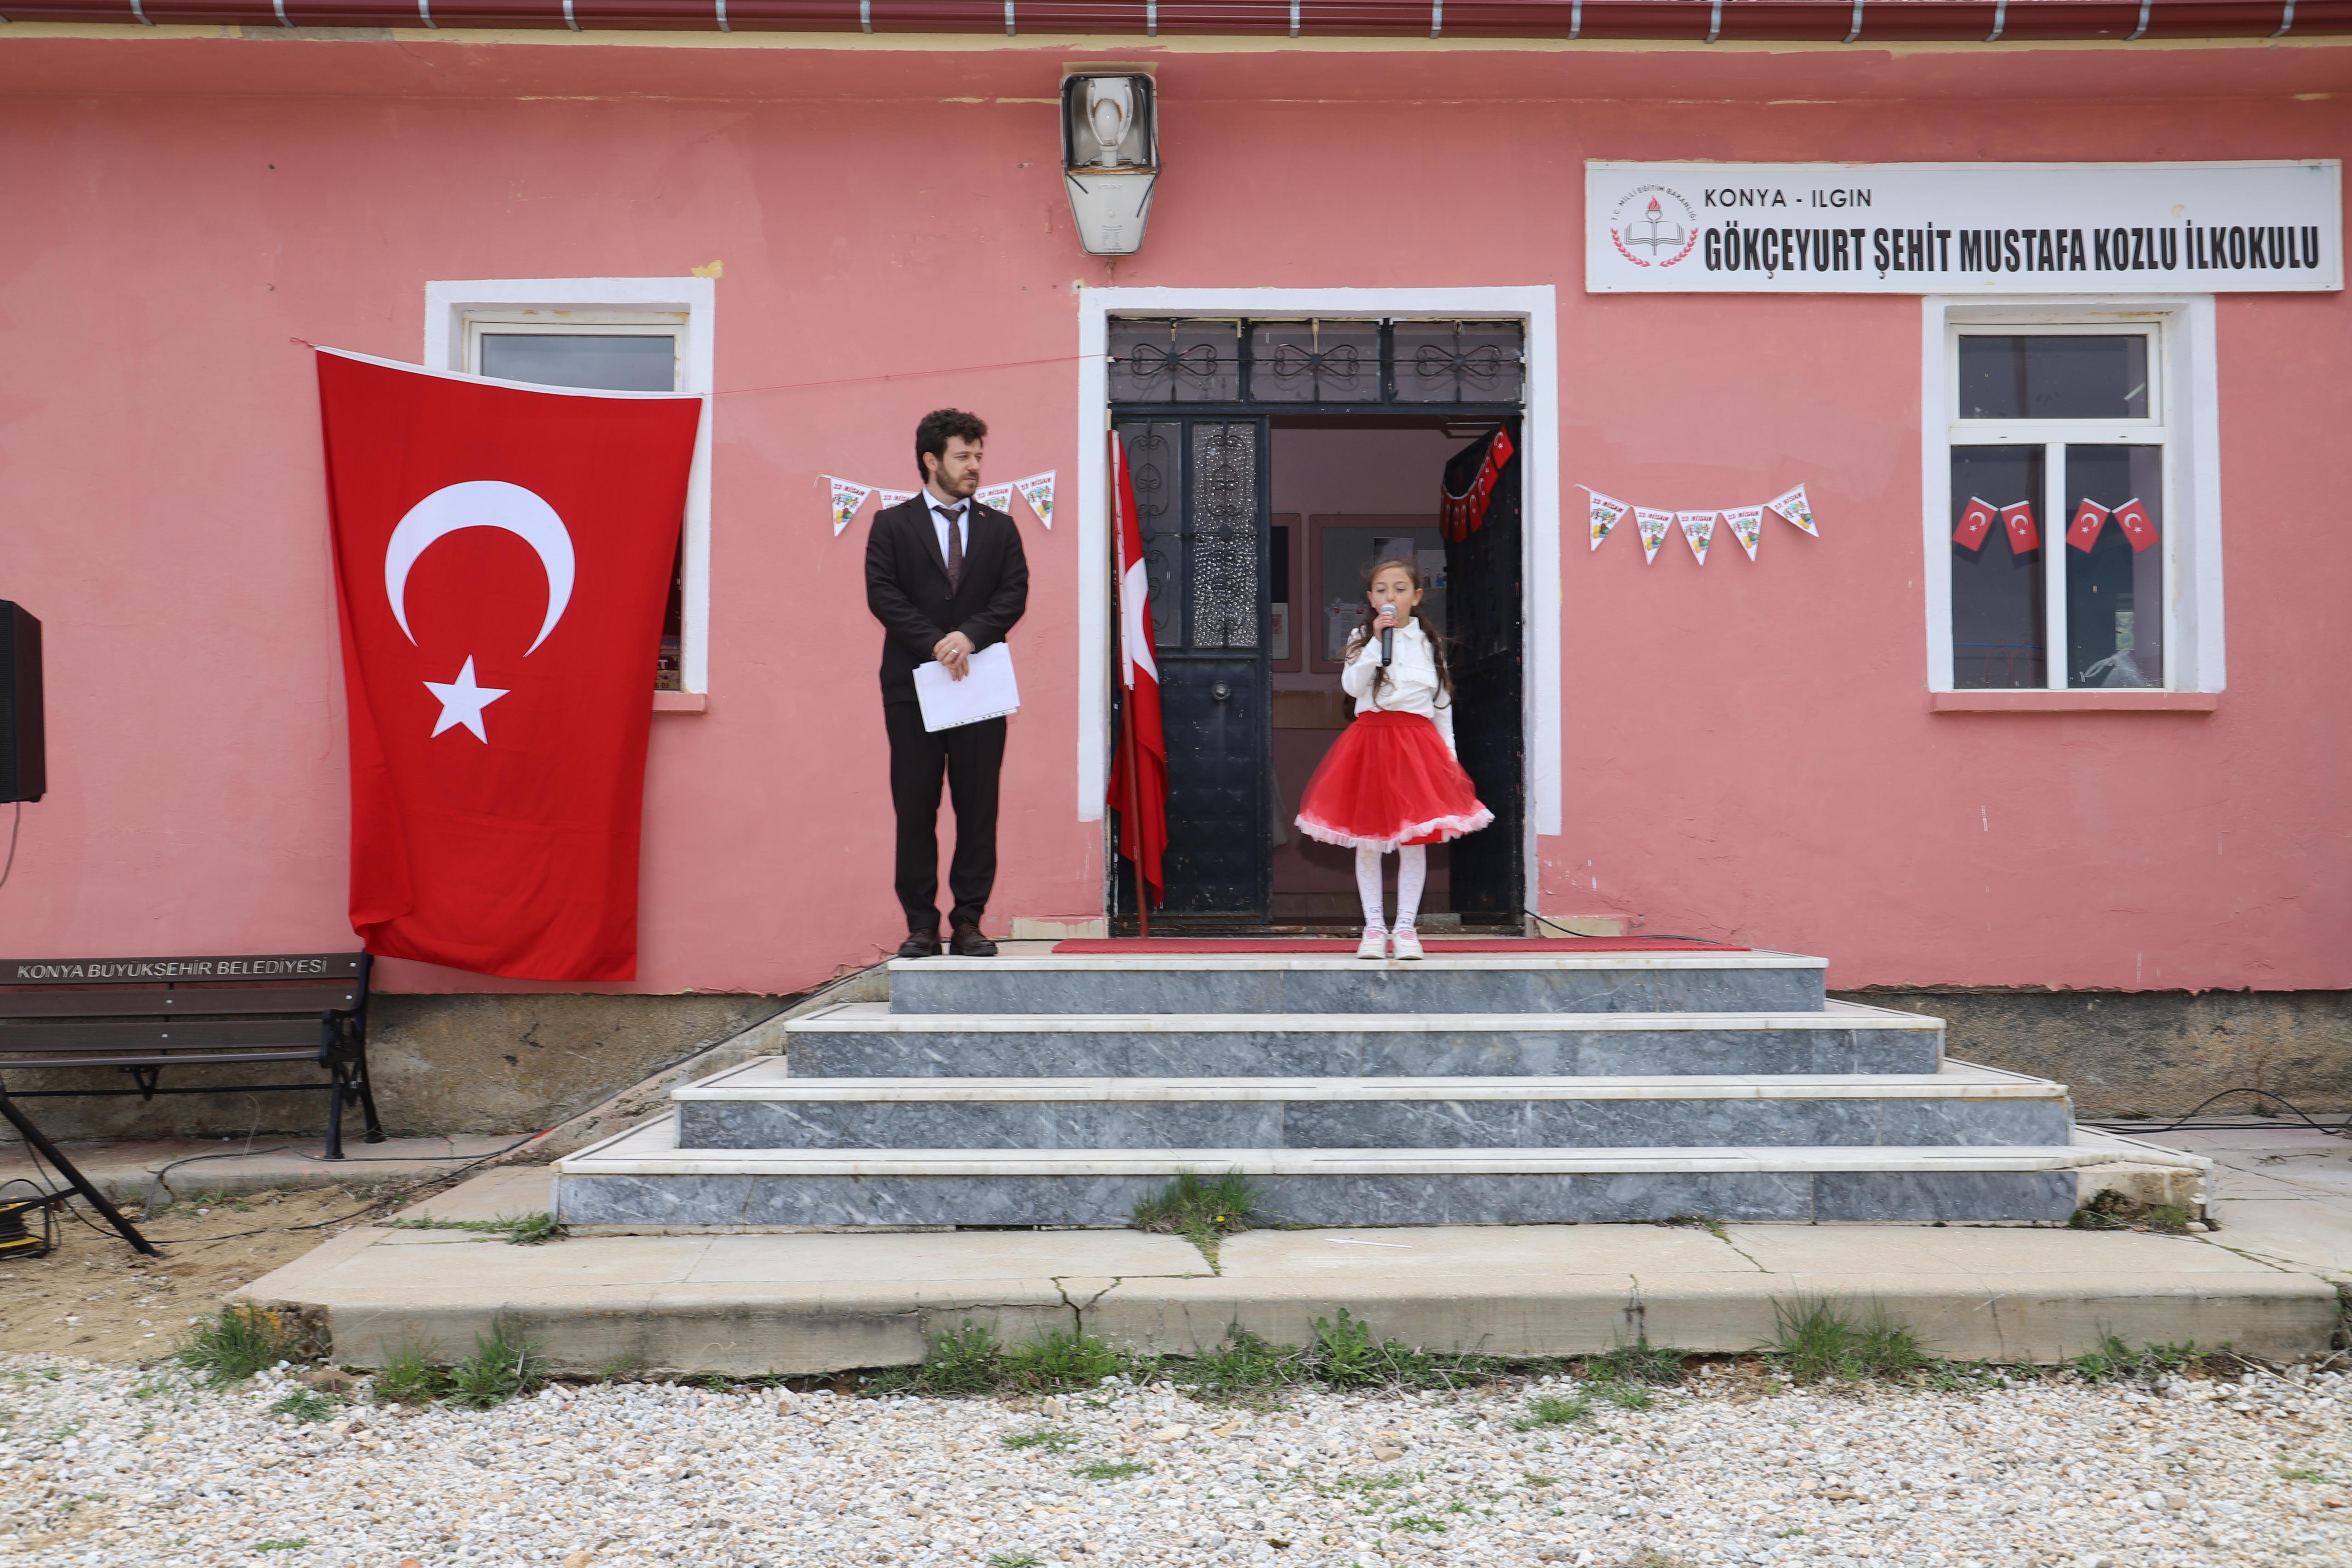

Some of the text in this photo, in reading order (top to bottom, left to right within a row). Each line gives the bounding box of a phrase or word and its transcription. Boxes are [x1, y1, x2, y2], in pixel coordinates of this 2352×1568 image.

[1705, 188, 1787, 207] KONYA
[1812, 189, 1872, 208] ILGIN
[1704, 219, 2319, 280] GÖKÇEYURT ŞEHİT MUSTAFA KOZLU İLKOKULU
[17, 957, 328, 979] KONYA BÜYÜKŞEHİR BELEDİYESİ
